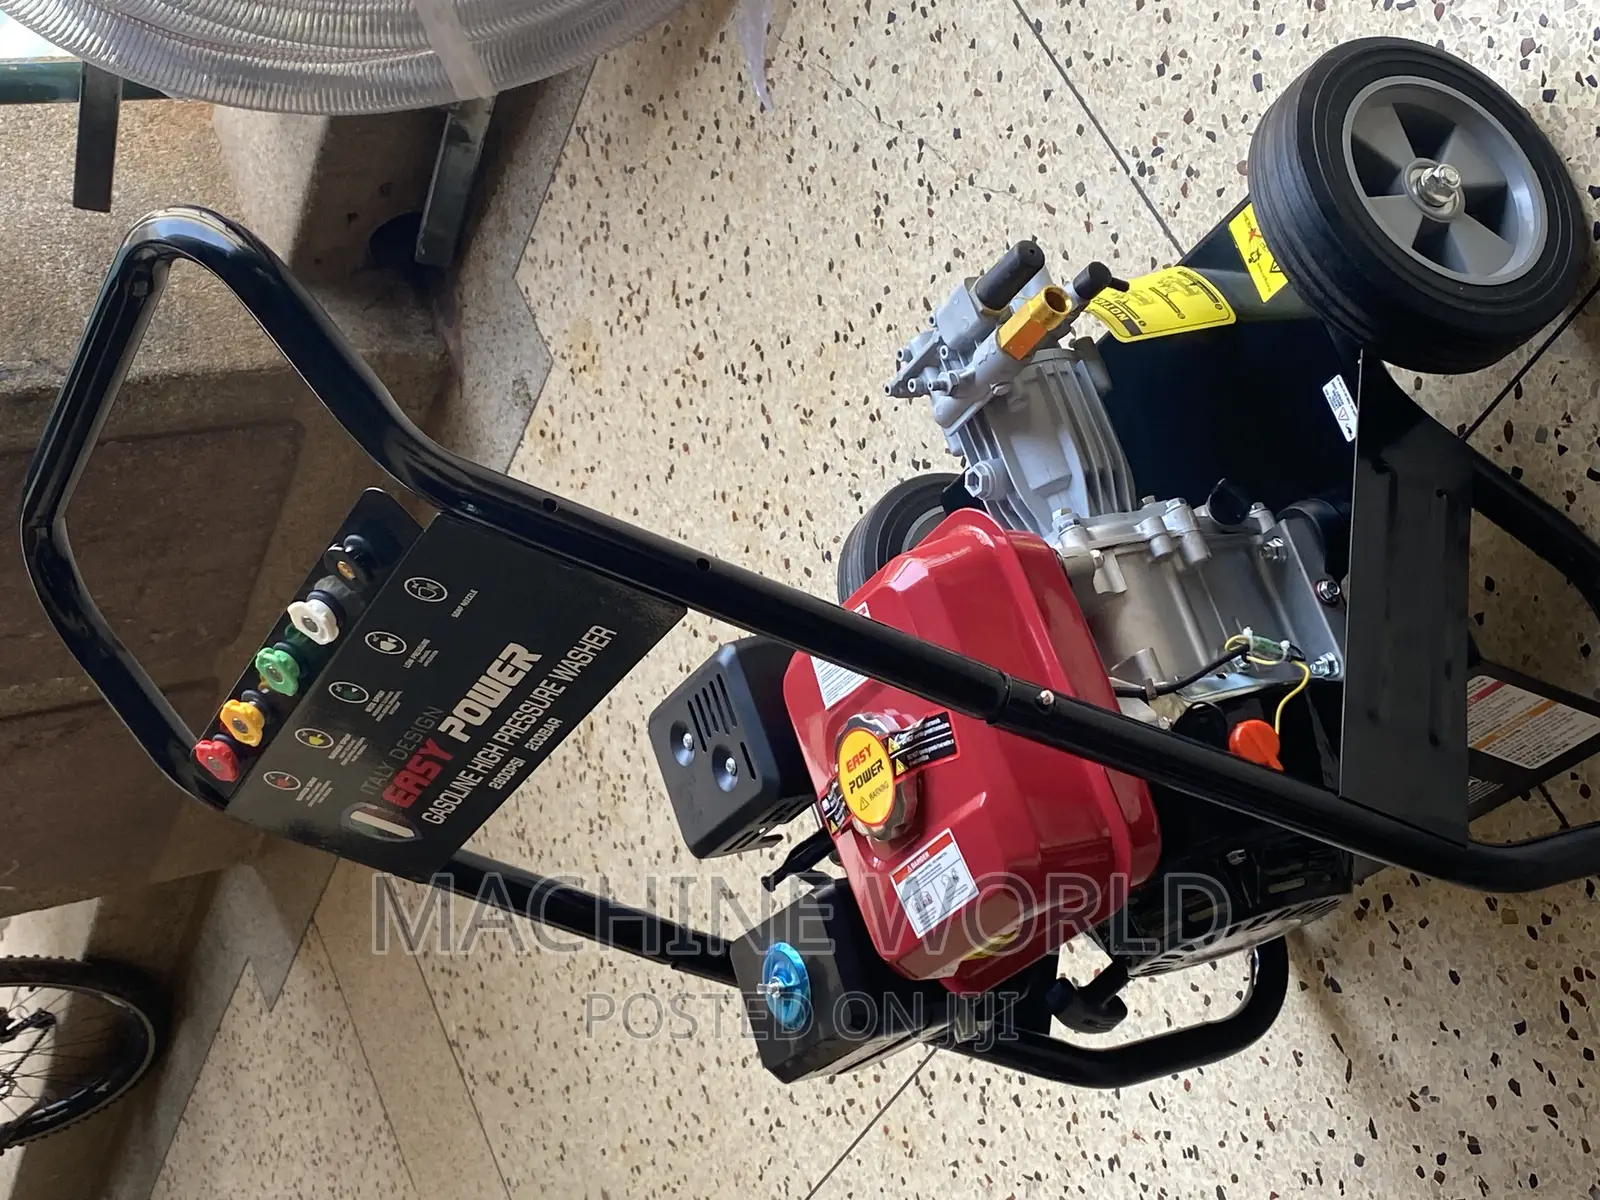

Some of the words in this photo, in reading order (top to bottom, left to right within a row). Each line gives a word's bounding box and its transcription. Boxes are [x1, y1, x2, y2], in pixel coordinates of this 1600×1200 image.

[1092, 297, 1130, 322] NOTIC
[383, 737, 454, 809] EASY
[437, 642, 543, 743] POWER
[421, 769, 484, 825] GASOLINE
[466, 742, 509, 775] HIGH
[492, 678, 567, 747] PRESSURE
[548, 624, 618, 682] WASHER
[524, 717, 564, 752] 200BAR
[360, 760, 397, 796] ITALY
[389, 705, 445, 761] DESIGN
[846, 743, 874, 774] EASY
[848, 758, 885, 795] POWER
[868, 780, 890, 802] WARNING
